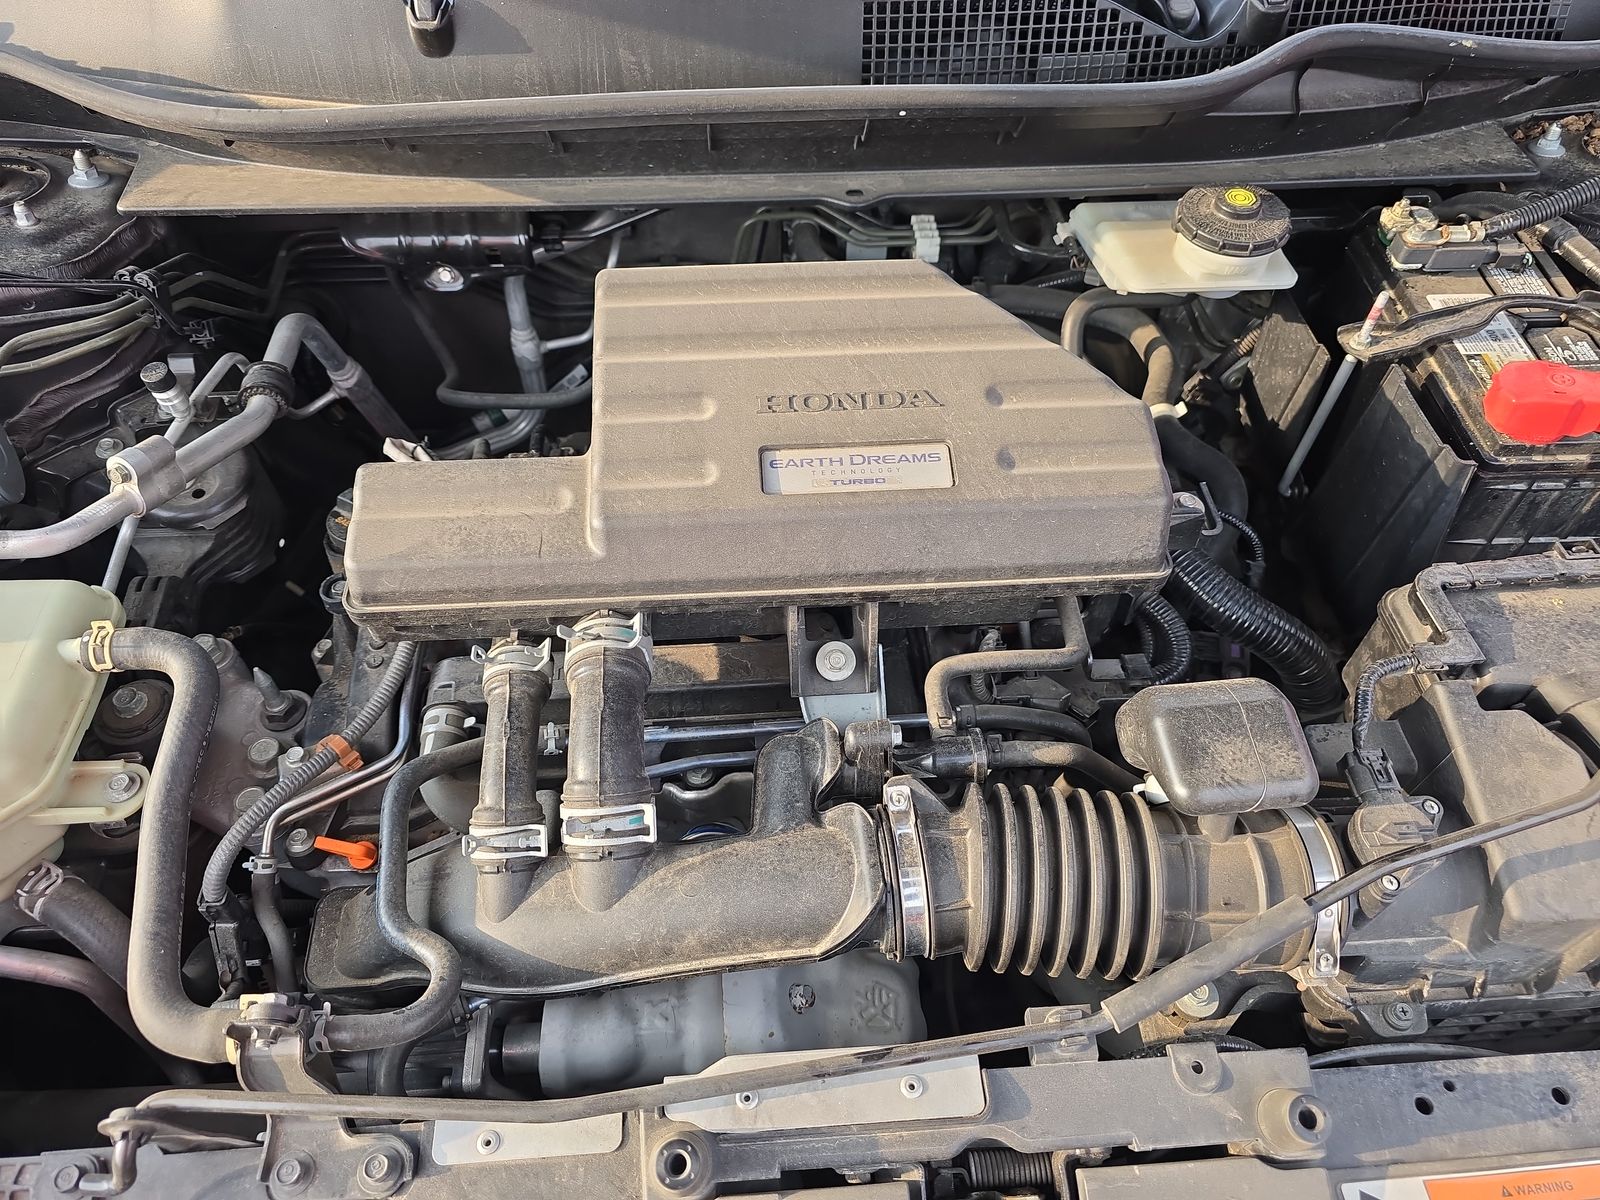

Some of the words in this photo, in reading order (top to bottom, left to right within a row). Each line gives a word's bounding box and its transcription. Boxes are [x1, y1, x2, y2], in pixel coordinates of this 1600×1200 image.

[756, 389, 945, 414] HONDA
[769, 455, 844, 469] EARTH
[849, 453, 942, 466] DREAMS
[812, 467, 902, 476] TECHNOLOGY
[831, 477, 886, 486] TURBO
[1514, 1180, 1573, 1196] WARNING
